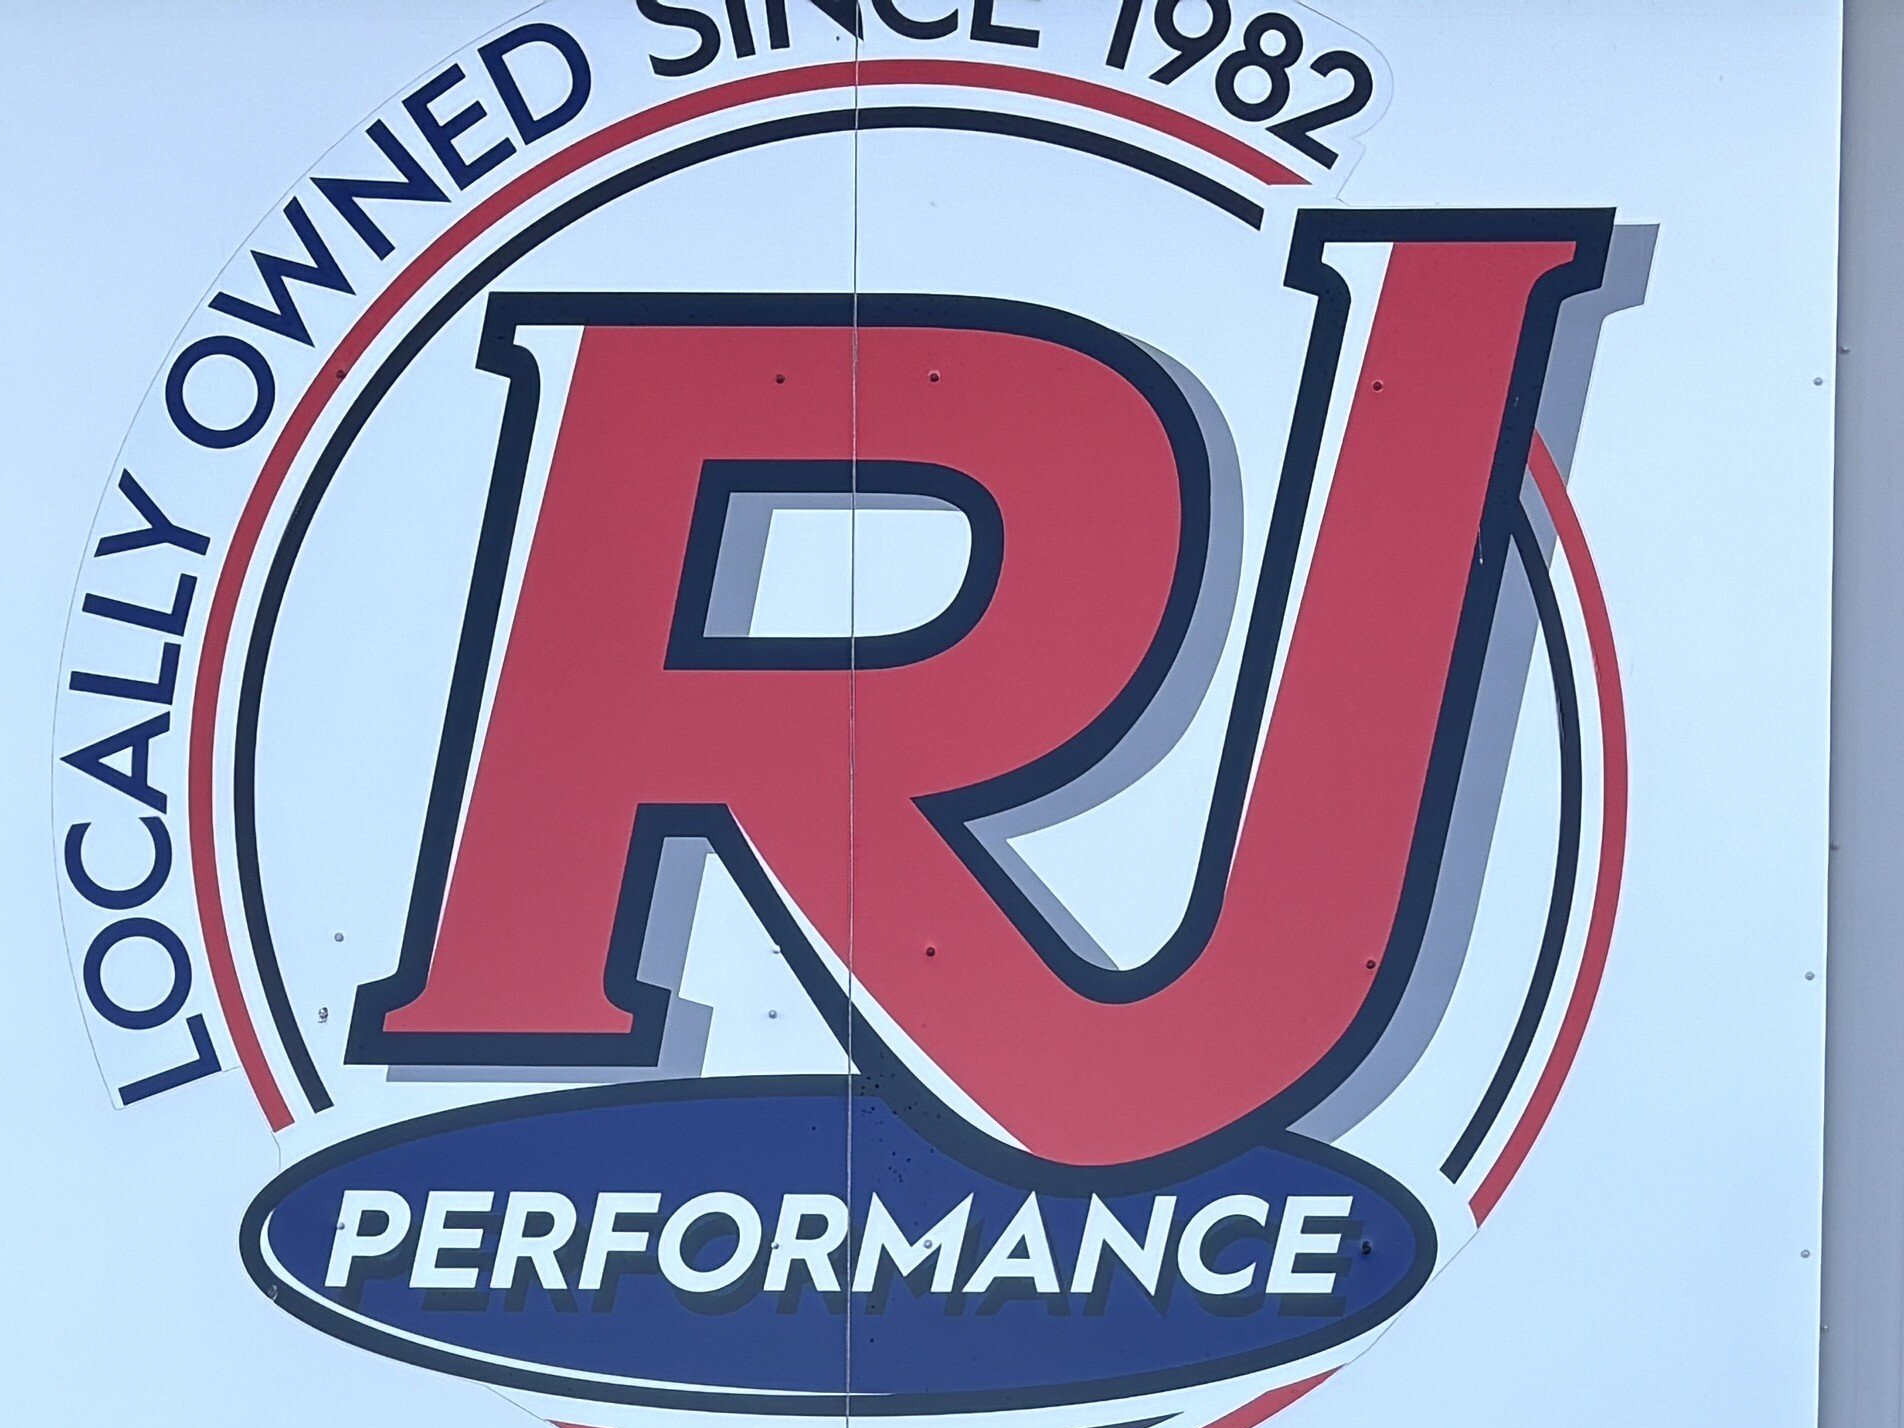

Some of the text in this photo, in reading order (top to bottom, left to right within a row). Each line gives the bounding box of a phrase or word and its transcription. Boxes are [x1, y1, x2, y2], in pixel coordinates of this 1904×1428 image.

[60, 467, 222, 1105] LOCALLY
[165, 23, 591, 448] OWNED
[1105, 0, 1373, 170] 1982
[346, 206, 1616, 1185] RJ
[325, 1188, 1354, 1296] PERFORMANCE
